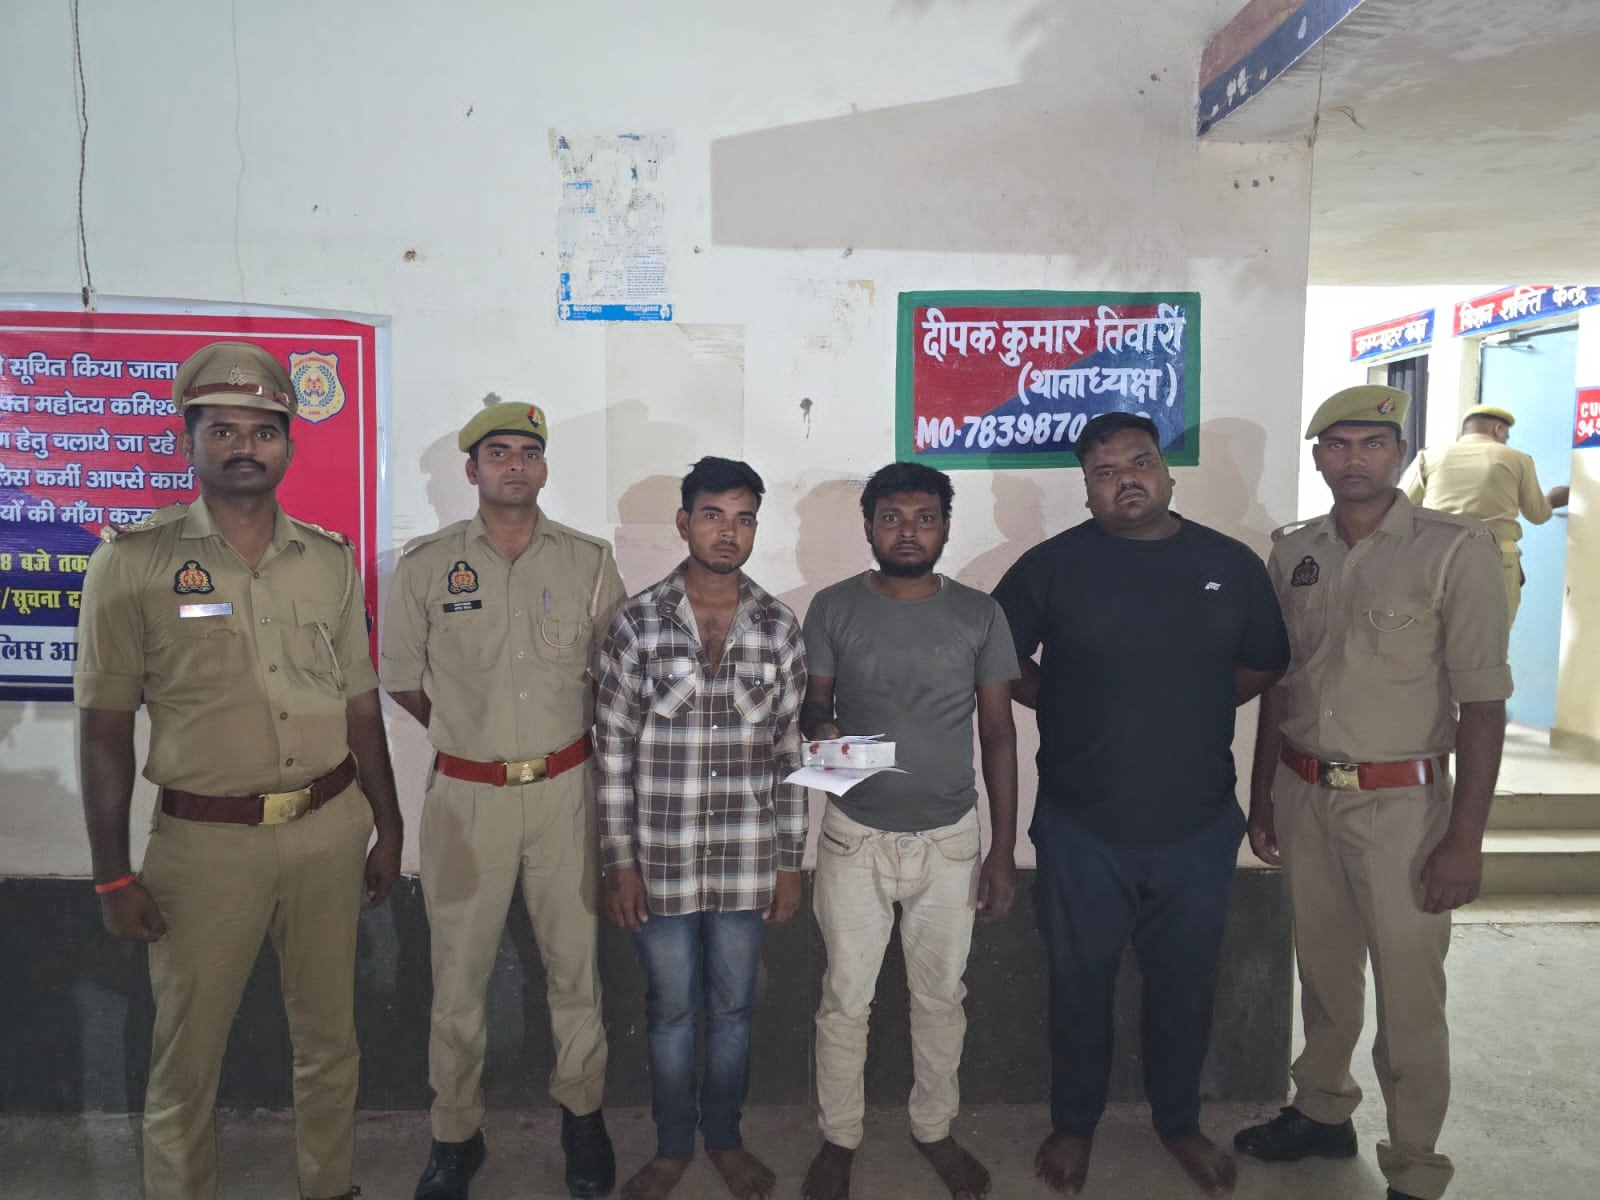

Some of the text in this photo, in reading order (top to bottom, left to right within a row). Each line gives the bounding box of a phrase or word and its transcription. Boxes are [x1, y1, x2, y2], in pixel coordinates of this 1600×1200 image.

[921, 308, 999, 362] दीपक
[998, 319, 1089, 367] कुमार
[9, 352, 67, 385] सूचित
[72, 353, 122, 379] किया
[127, 362, 179, 379] जाता
[34, 391, 105, 415] महोदय
[1581, 402, 1600, 418] CU
[16, 427, 49, 459] हेतु
[52, 428, 110, 452] चलाये
[113, 435, 144, 452] जा
[147, 430, 177, 454] रहे
[35, 463, 82, 488] कर्मी
[86, 465, 146, 489] आपसे
[150, 466, 195, 490] कार्य
[27, 500, 57, 523] की
[60, 501, 105, 524] माँग
[18, 548, 52, 572] बजे
